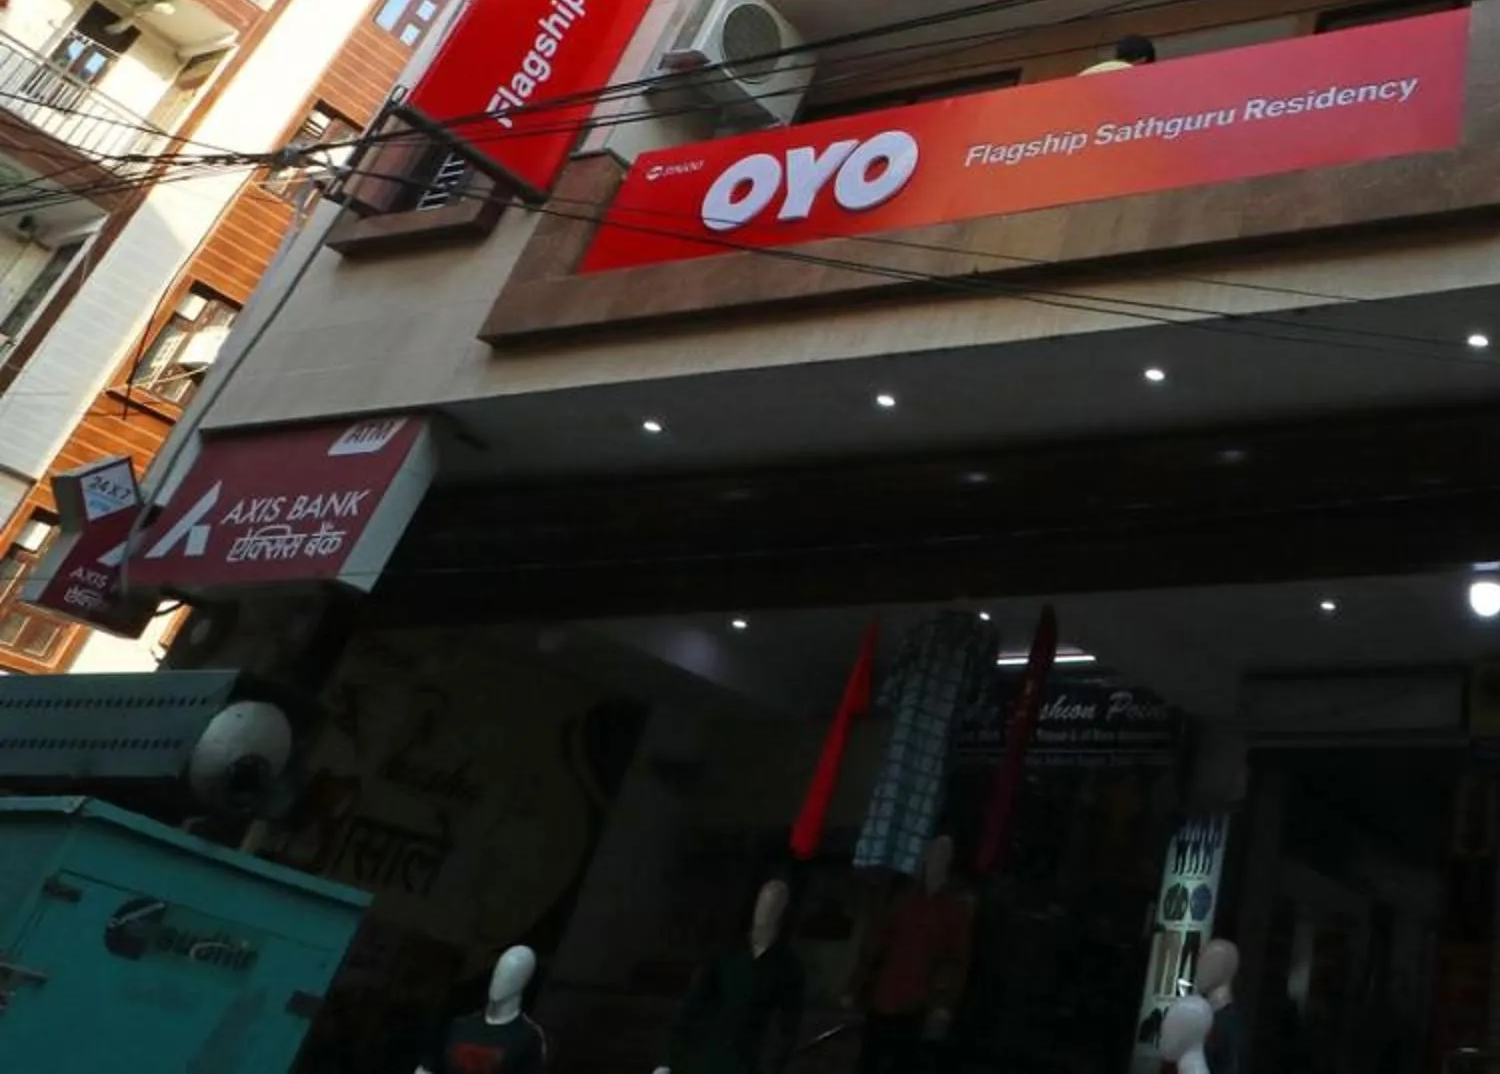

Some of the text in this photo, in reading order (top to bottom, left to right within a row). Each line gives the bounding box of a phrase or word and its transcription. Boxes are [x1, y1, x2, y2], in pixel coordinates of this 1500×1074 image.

[964, 72, 1420, 169] Flagship Sathguru Residency
[701, 128, 919, 232] OYO
[220, 488, 372, 525] AXIS BANK
